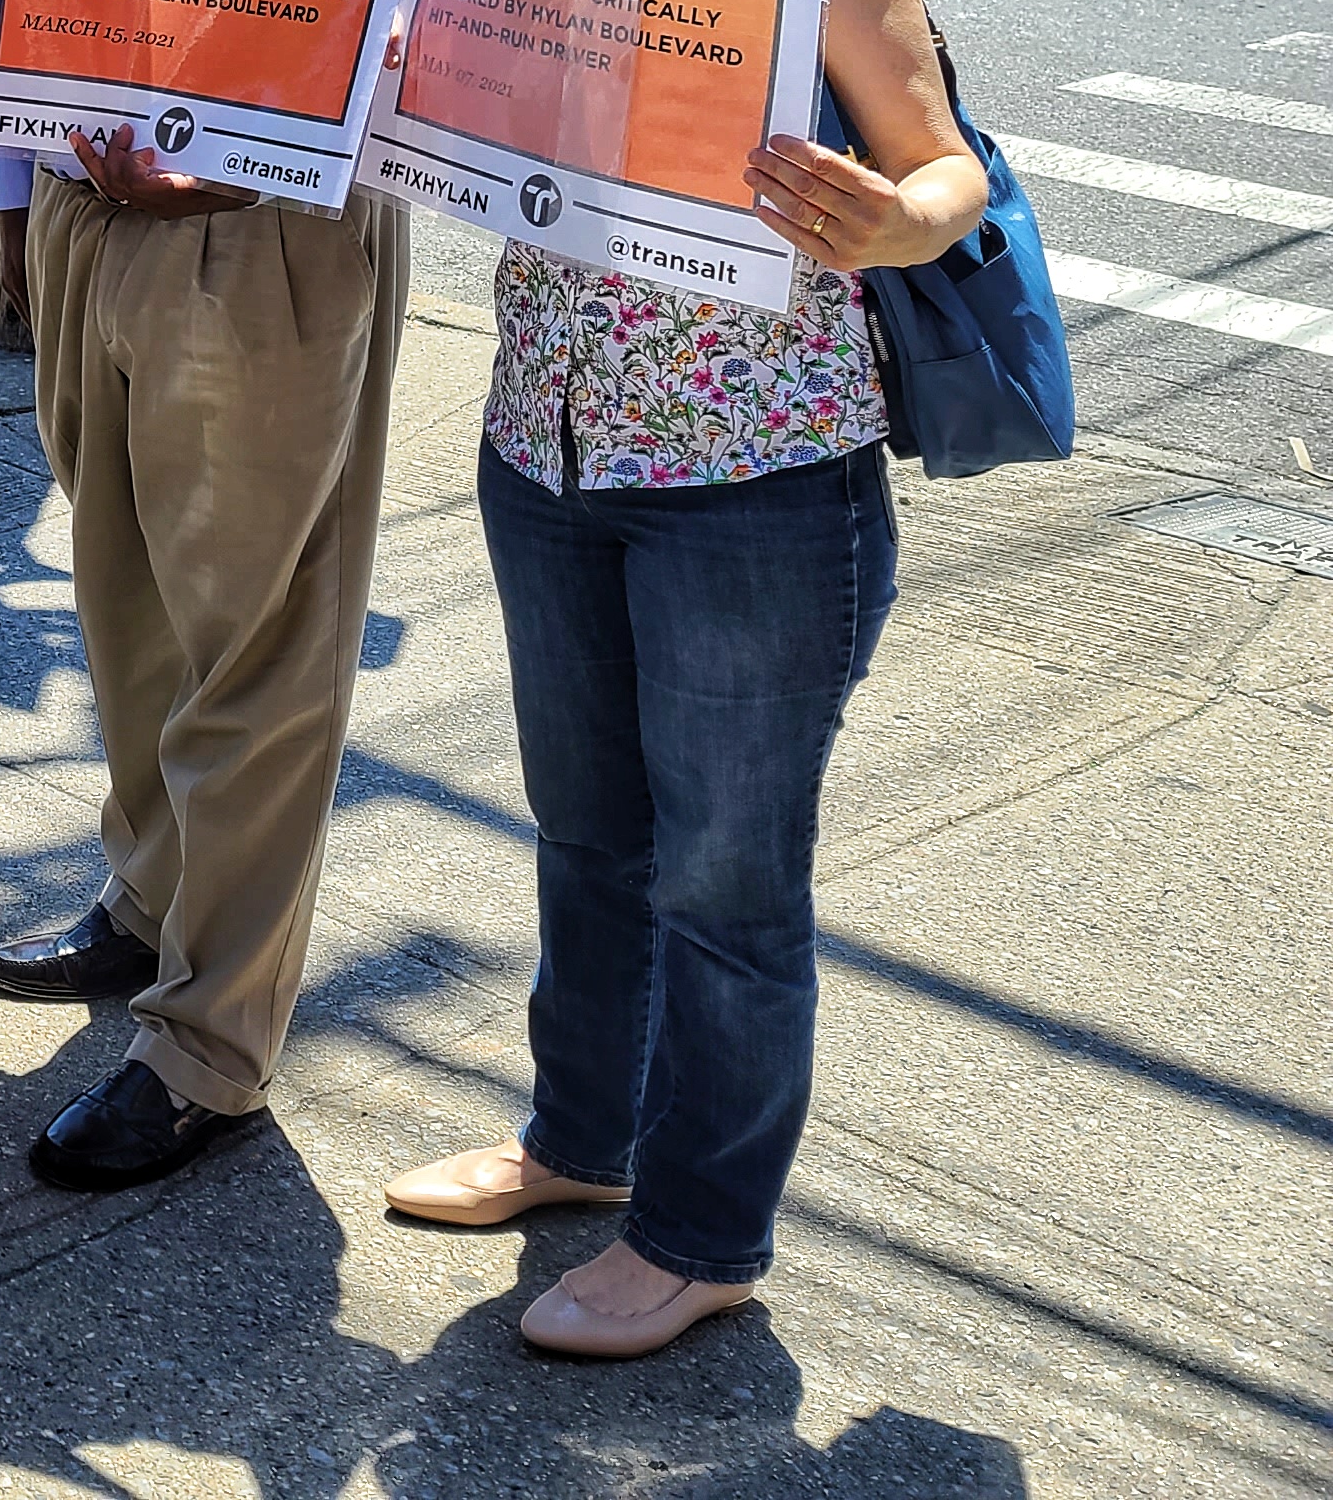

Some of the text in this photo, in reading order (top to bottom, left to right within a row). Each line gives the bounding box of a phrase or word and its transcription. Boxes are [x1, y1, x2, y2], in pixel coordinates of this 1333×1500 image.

[19, 13, 176, 49] MARCH 15, 2021
[428, 6, 535, 53] HIT-AND-RUN
[531, 3, 594, 36] HYLAN
[600, 20, 745, 67] BOULEVARD
[478, 75, 516, 99] 2021
[223, 152, 323, 190] @transalt
[380, 158, 739, 285] #FIXHYLAN @transalt
